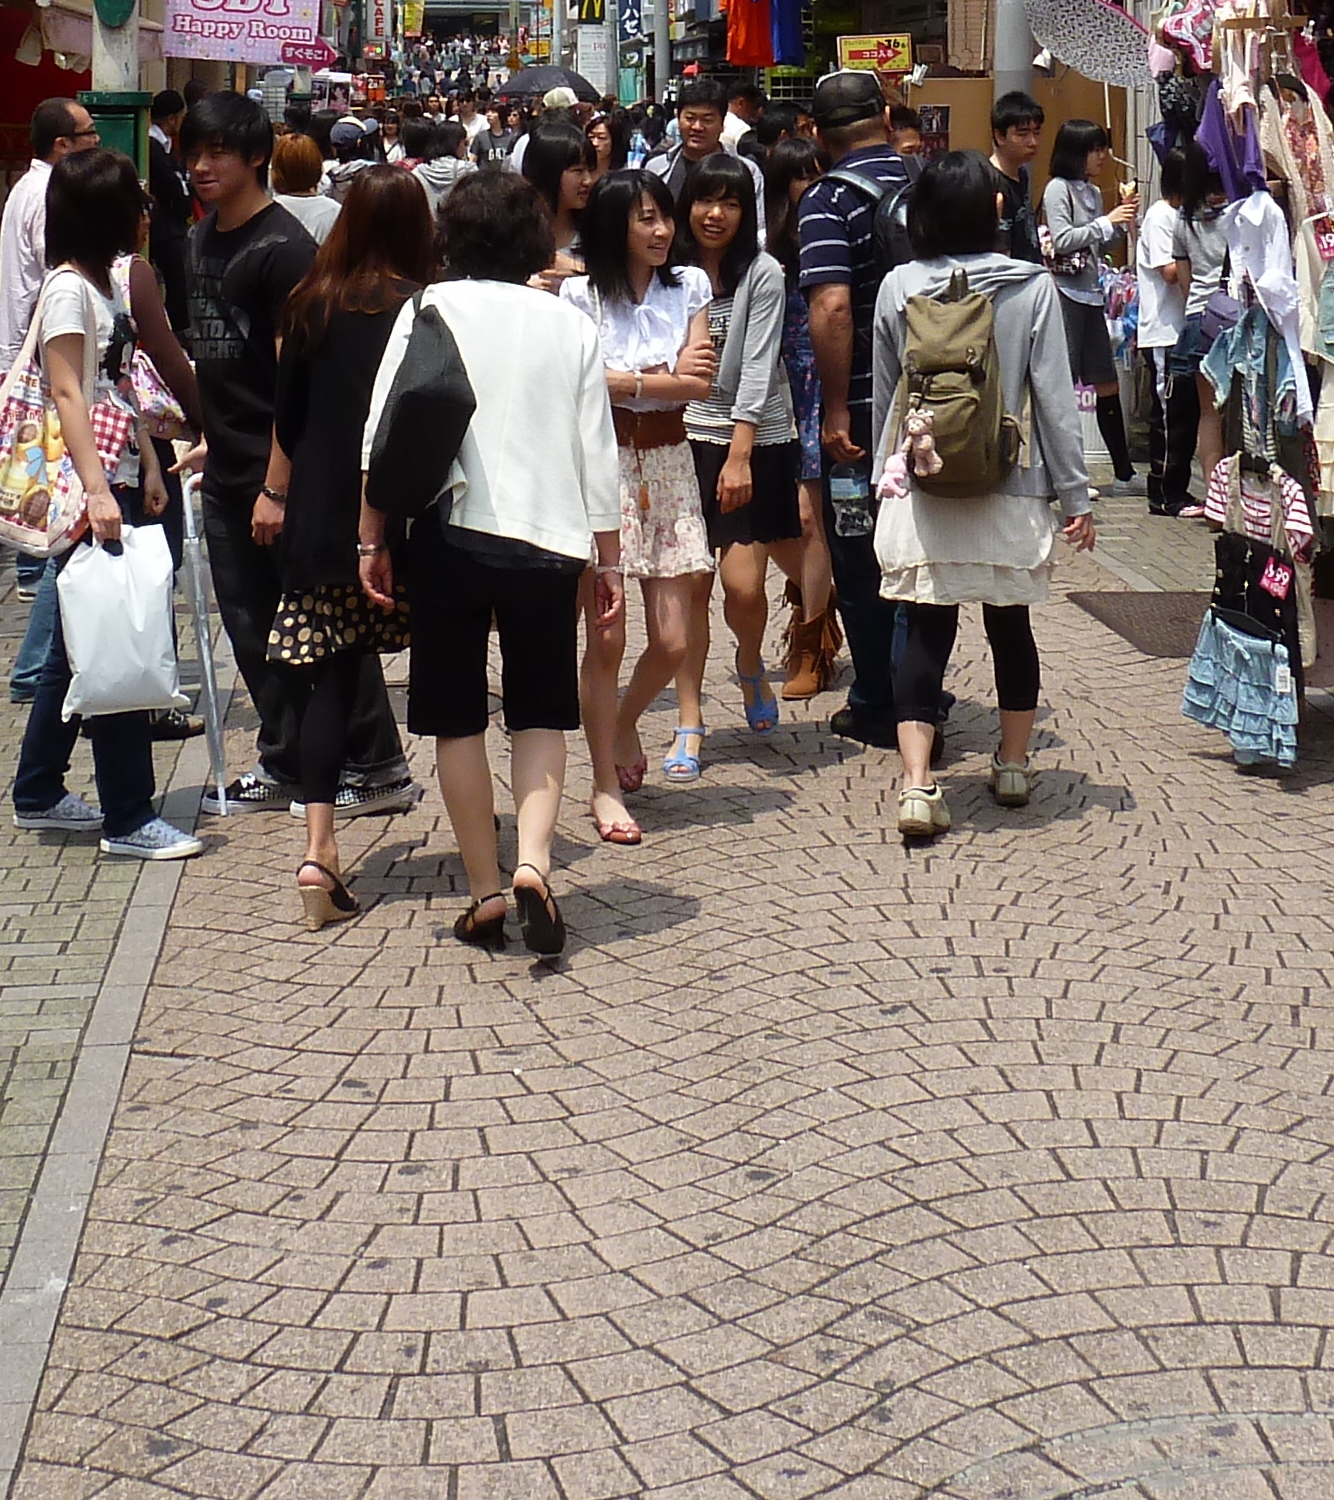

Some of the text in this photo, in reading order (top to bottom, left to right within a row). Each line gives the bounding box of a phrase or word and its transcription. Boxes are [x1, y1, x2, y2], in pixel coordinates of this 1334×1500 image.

[173, 13, 312, 42] Happy Room
[373, 0, 385, 37] CAFE
[283, 46, 329, 62] すぐそこ!
